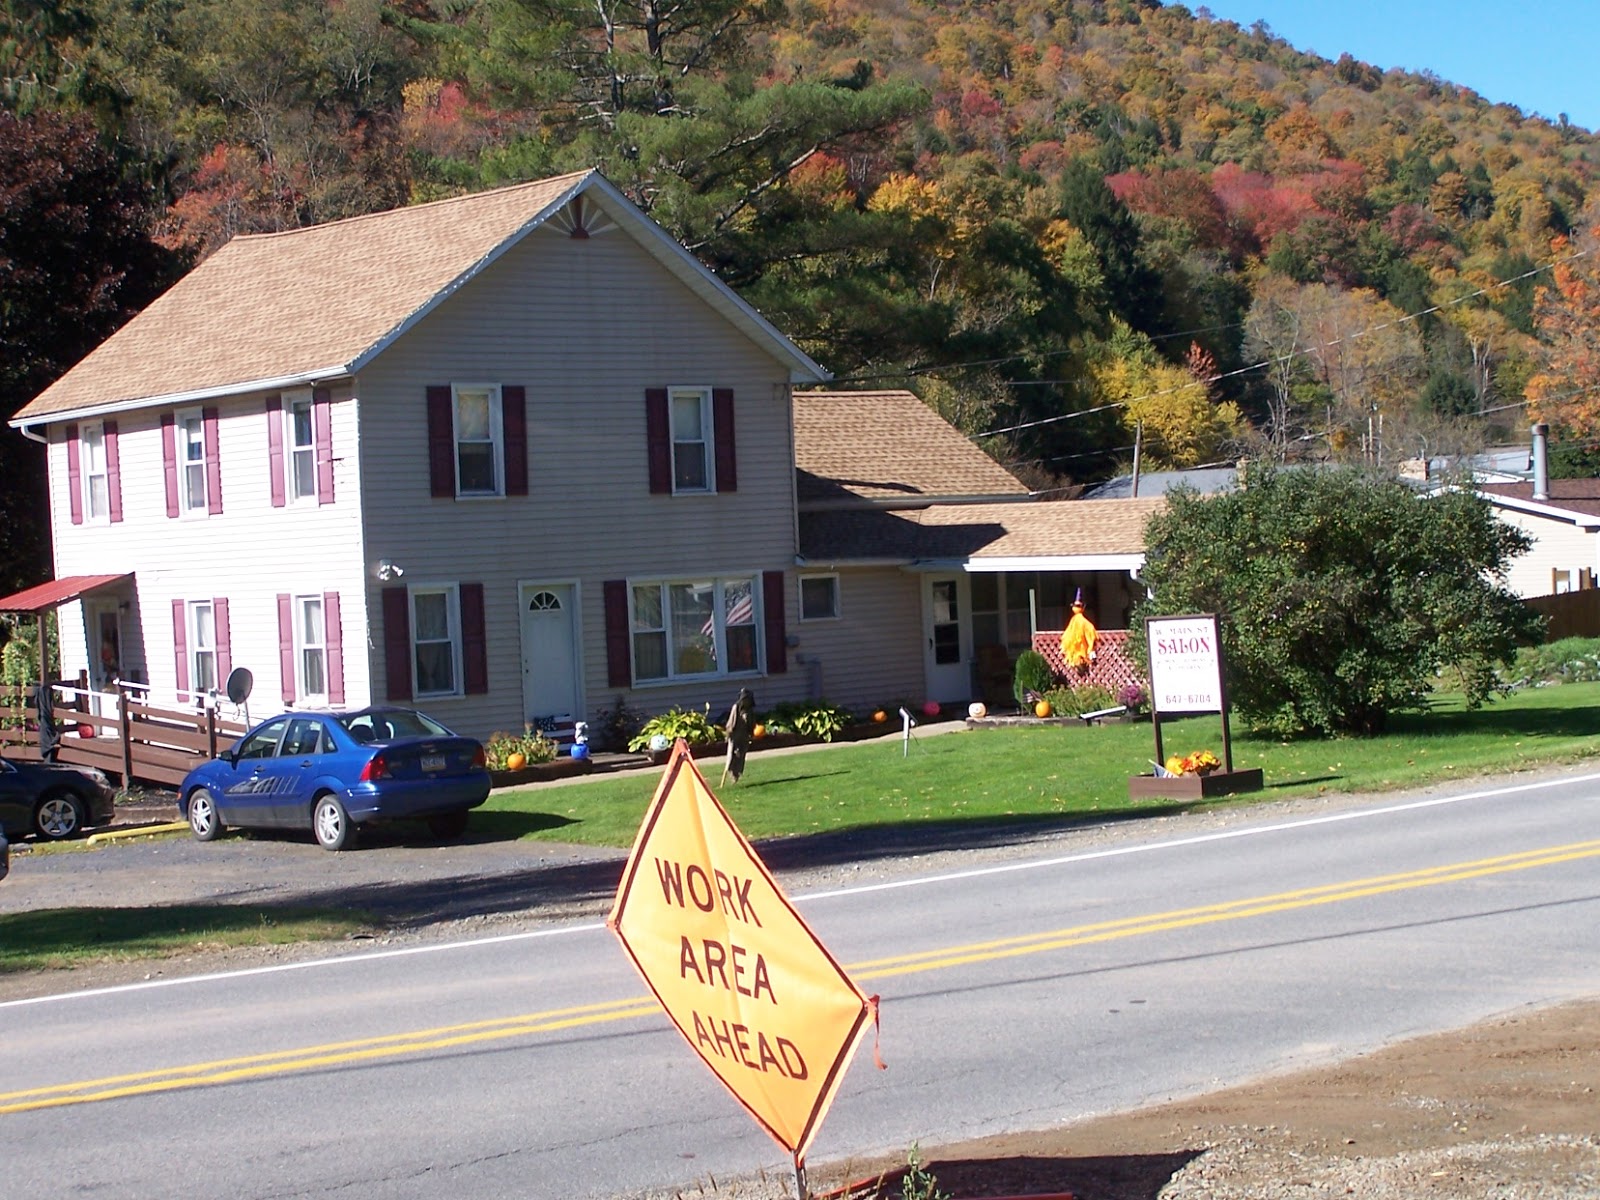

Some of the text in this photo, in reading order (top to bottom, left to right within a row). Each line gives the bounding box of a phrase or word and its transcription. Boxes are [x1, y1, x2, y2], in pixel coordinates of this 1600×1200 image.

[1158, 636, 1210, 655] SALON
[1165, 694, 1211, 704] 647-6704
[654, 857, 762, 928] WORK
[680, 935, 778, 1006] AREA
[692, 1010, 809, 1081] AHEAD
